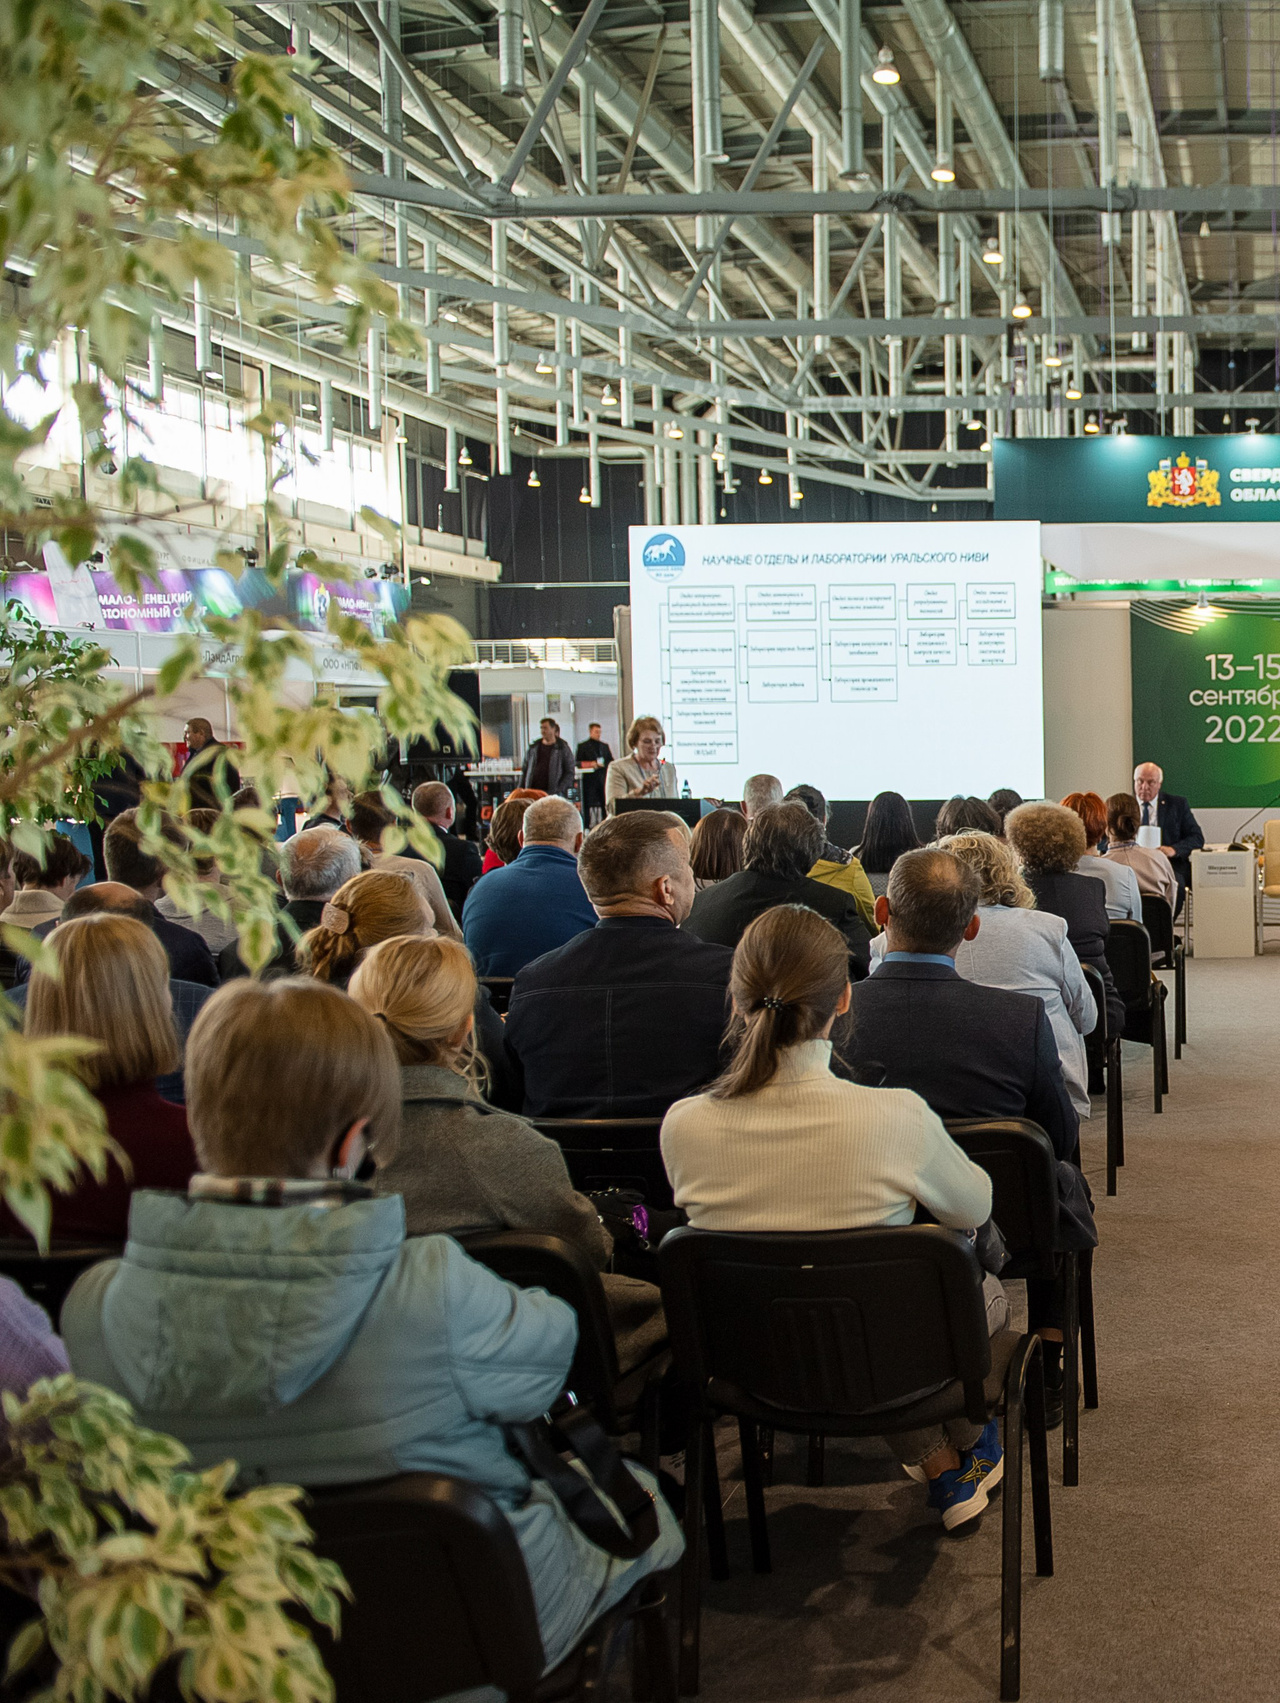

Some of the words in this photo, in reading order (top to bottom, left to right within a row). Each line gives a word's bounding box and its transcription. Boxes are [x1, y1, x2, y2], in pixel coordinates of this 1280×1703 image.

[702, 553, 752, 567] НАУЧНЫЕ
[755, 554, 799, 566] ОТДЕЛЫ
[801, 554, 809, 565] И
[811, 553, 888, 565] ЛАБОРАТОРИИ
[890, 552, 957, 564] УРАЛЬСКОГО
[959, 552, 990, 563] НИВИ
